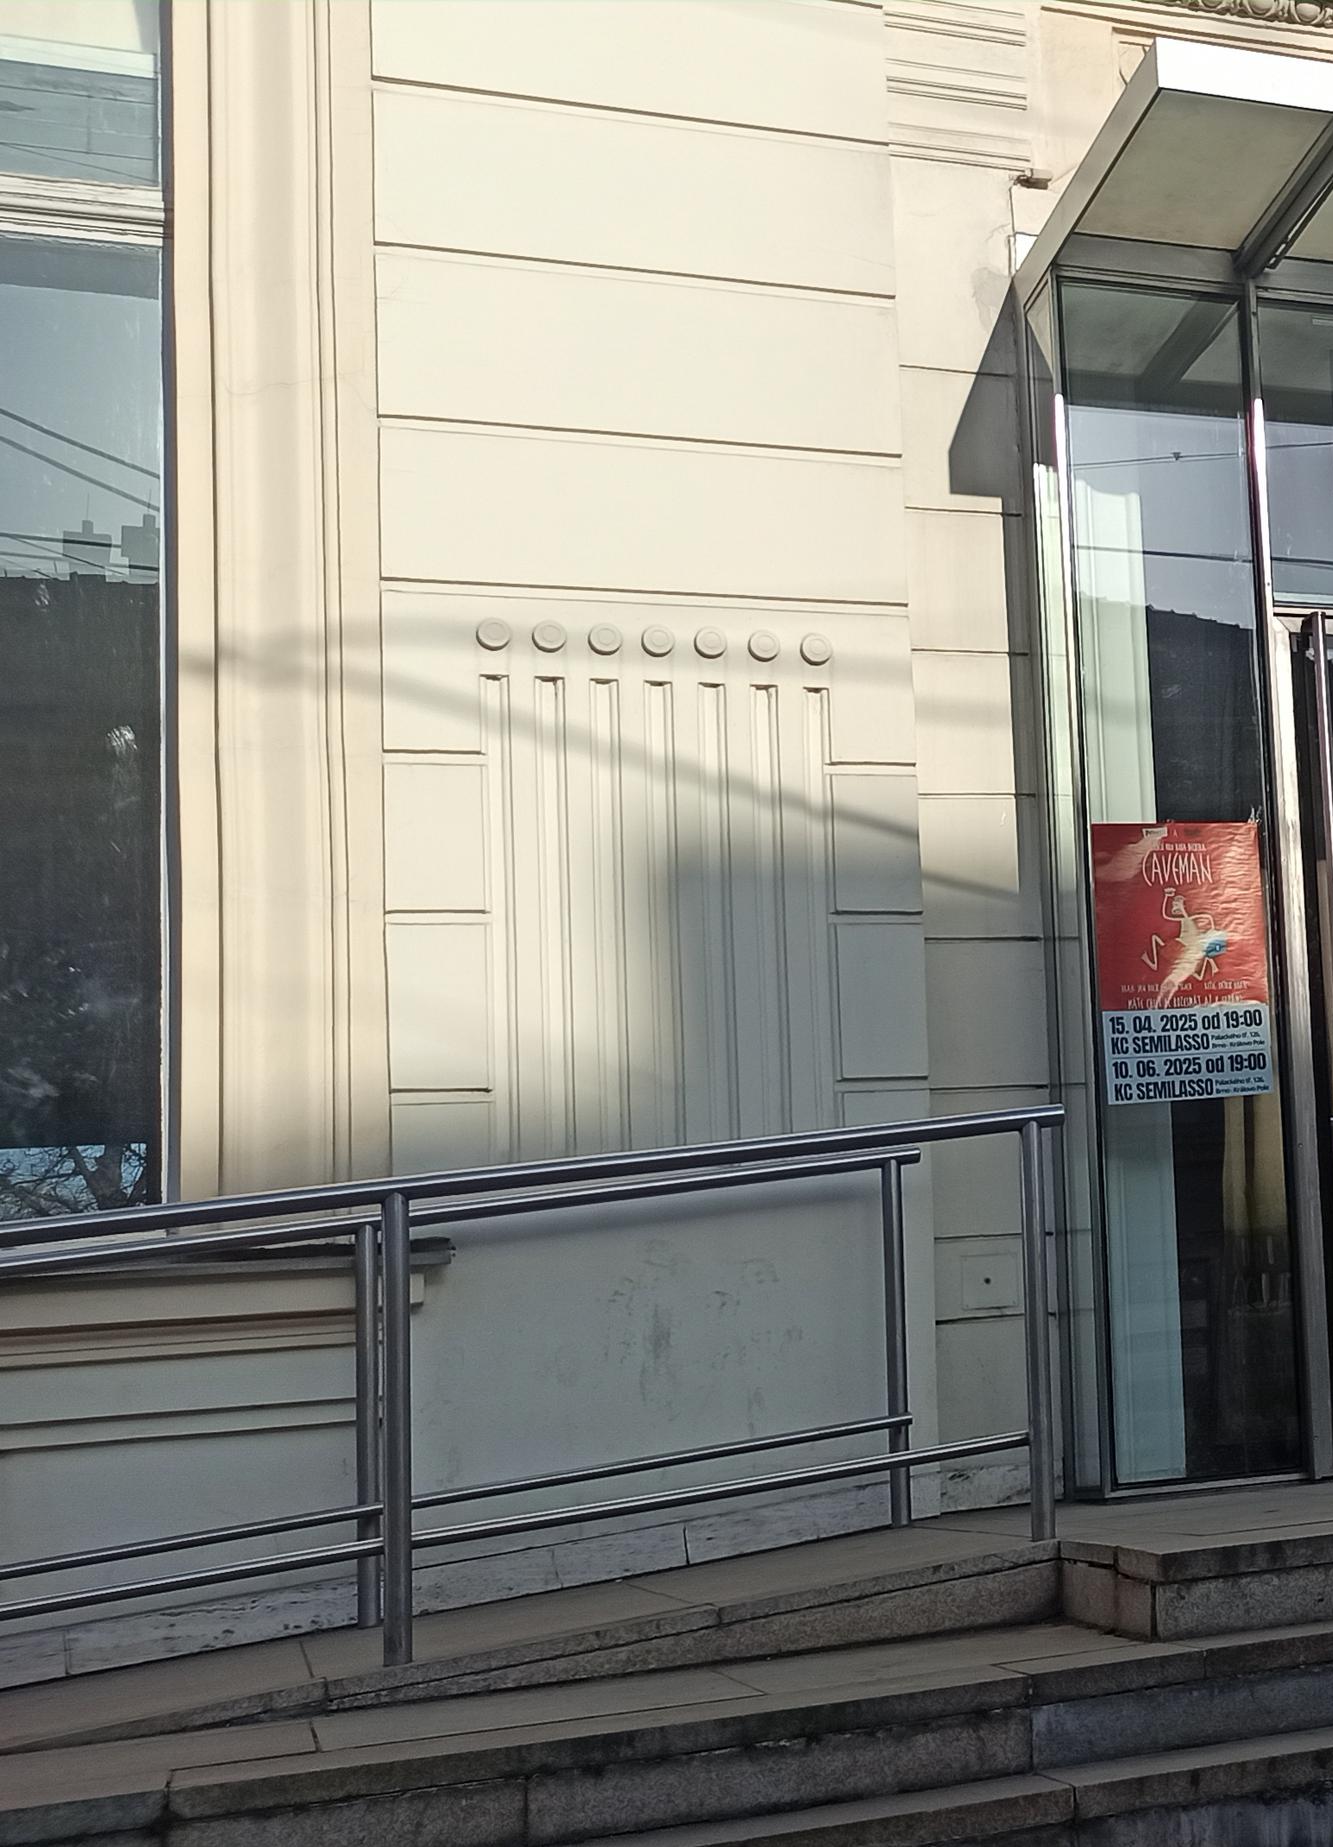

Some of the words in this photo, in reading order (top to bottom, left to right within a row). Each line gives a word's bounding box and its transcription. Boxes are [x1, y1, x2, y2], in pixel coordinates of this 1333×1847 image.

[1142, 851, 1214, 887] CAVEMAN
[1109, 1016, 1130, 1035] 15.
[1133, 1015, 1157, 1034] 04.
[1160, 1013, 1198, 1033] 2025
[1201, 1011, 1221, 1031] od
[1224, 1009, 1263, 1029] 19:00
[1111, 1036, 1129, 1055] KC
[1133, 1033, 1210, 1054] SEMILASSO
[1112, 1061, 1133, 1080] 10.
[1136, 1059, 1160, 1078] 06.
[1164, 1057, 1201, 1077] 2025
[1206, 1055, 1225, 1074] od
[1227, 1052, 1267, 1073] 19:00
[1114, 1082, 1133, 1102] KC
[1137, 1078, 1214, 1101] SEMILASSO
